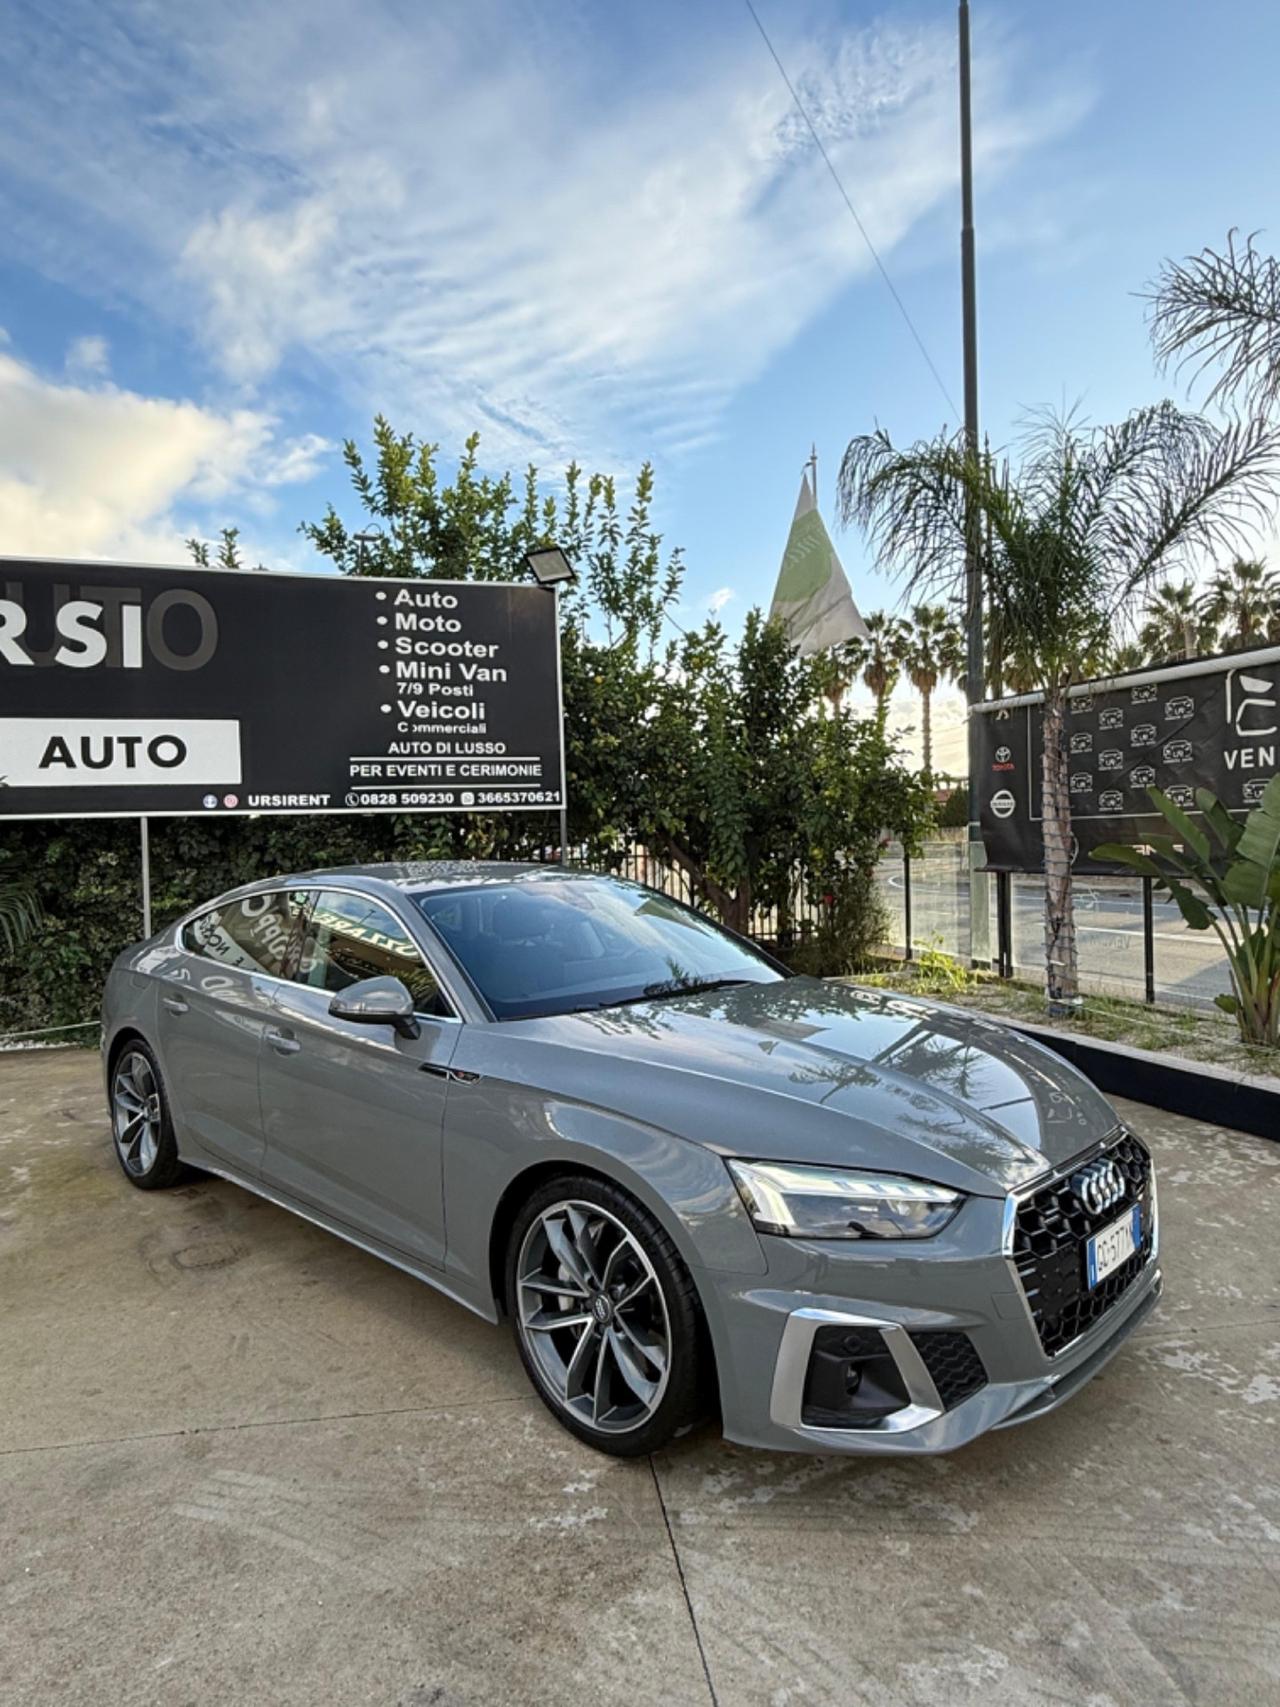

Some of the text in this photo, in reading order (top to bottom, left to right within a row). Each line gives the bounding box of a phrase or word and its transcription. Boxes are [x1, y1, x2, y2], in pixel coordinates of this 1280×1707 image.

[394, 589, 458, 609] Auto
[395, 613, 461, 632] Moto
[395, 637, 499, 658] Scooter
[396, 661, 507, 682] Mini Van
[396, 682, 474, 697] 7/9 Posti
[397, 700, 485, 719] Veicoli
[38, 734, 187, 768] AUTO
[388, 742, 506, 754] AUTO DI LUSSO
[350, 764, 542, 777] PER EVENTI E CERIMONIE
[248, 794, 331, 806] URSIRENT
[360, 793, 454, 805] 0828 509230
